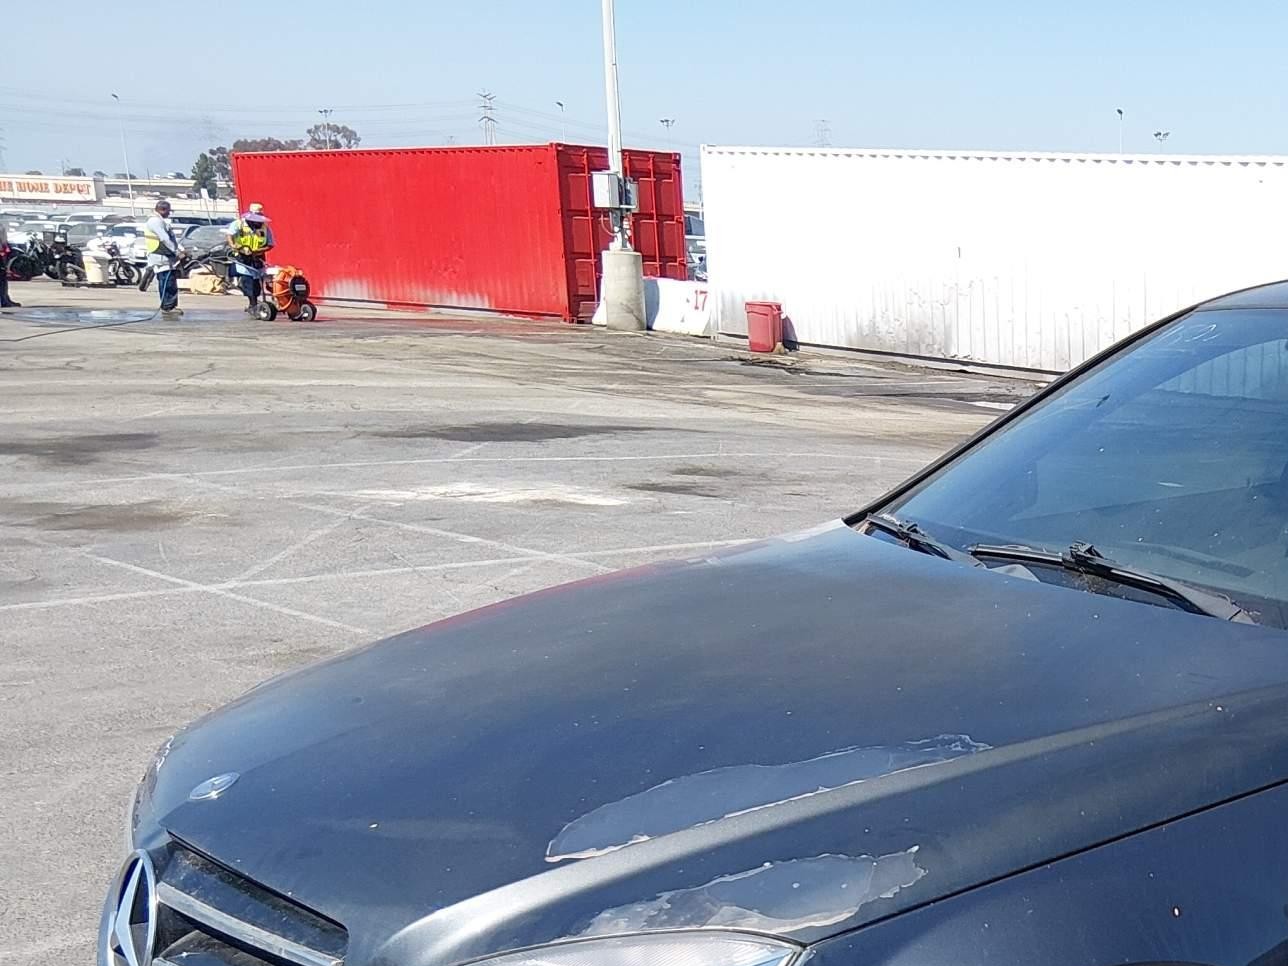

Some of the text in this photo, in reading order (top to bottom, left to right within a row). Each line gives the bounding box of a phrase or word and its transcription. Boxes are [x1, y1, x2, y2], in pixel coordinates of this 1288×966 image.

[16, 181, 50, 194] HOME
[53, 182, 91, 195] DEPOT
[694, 289, 708, 311] 17
